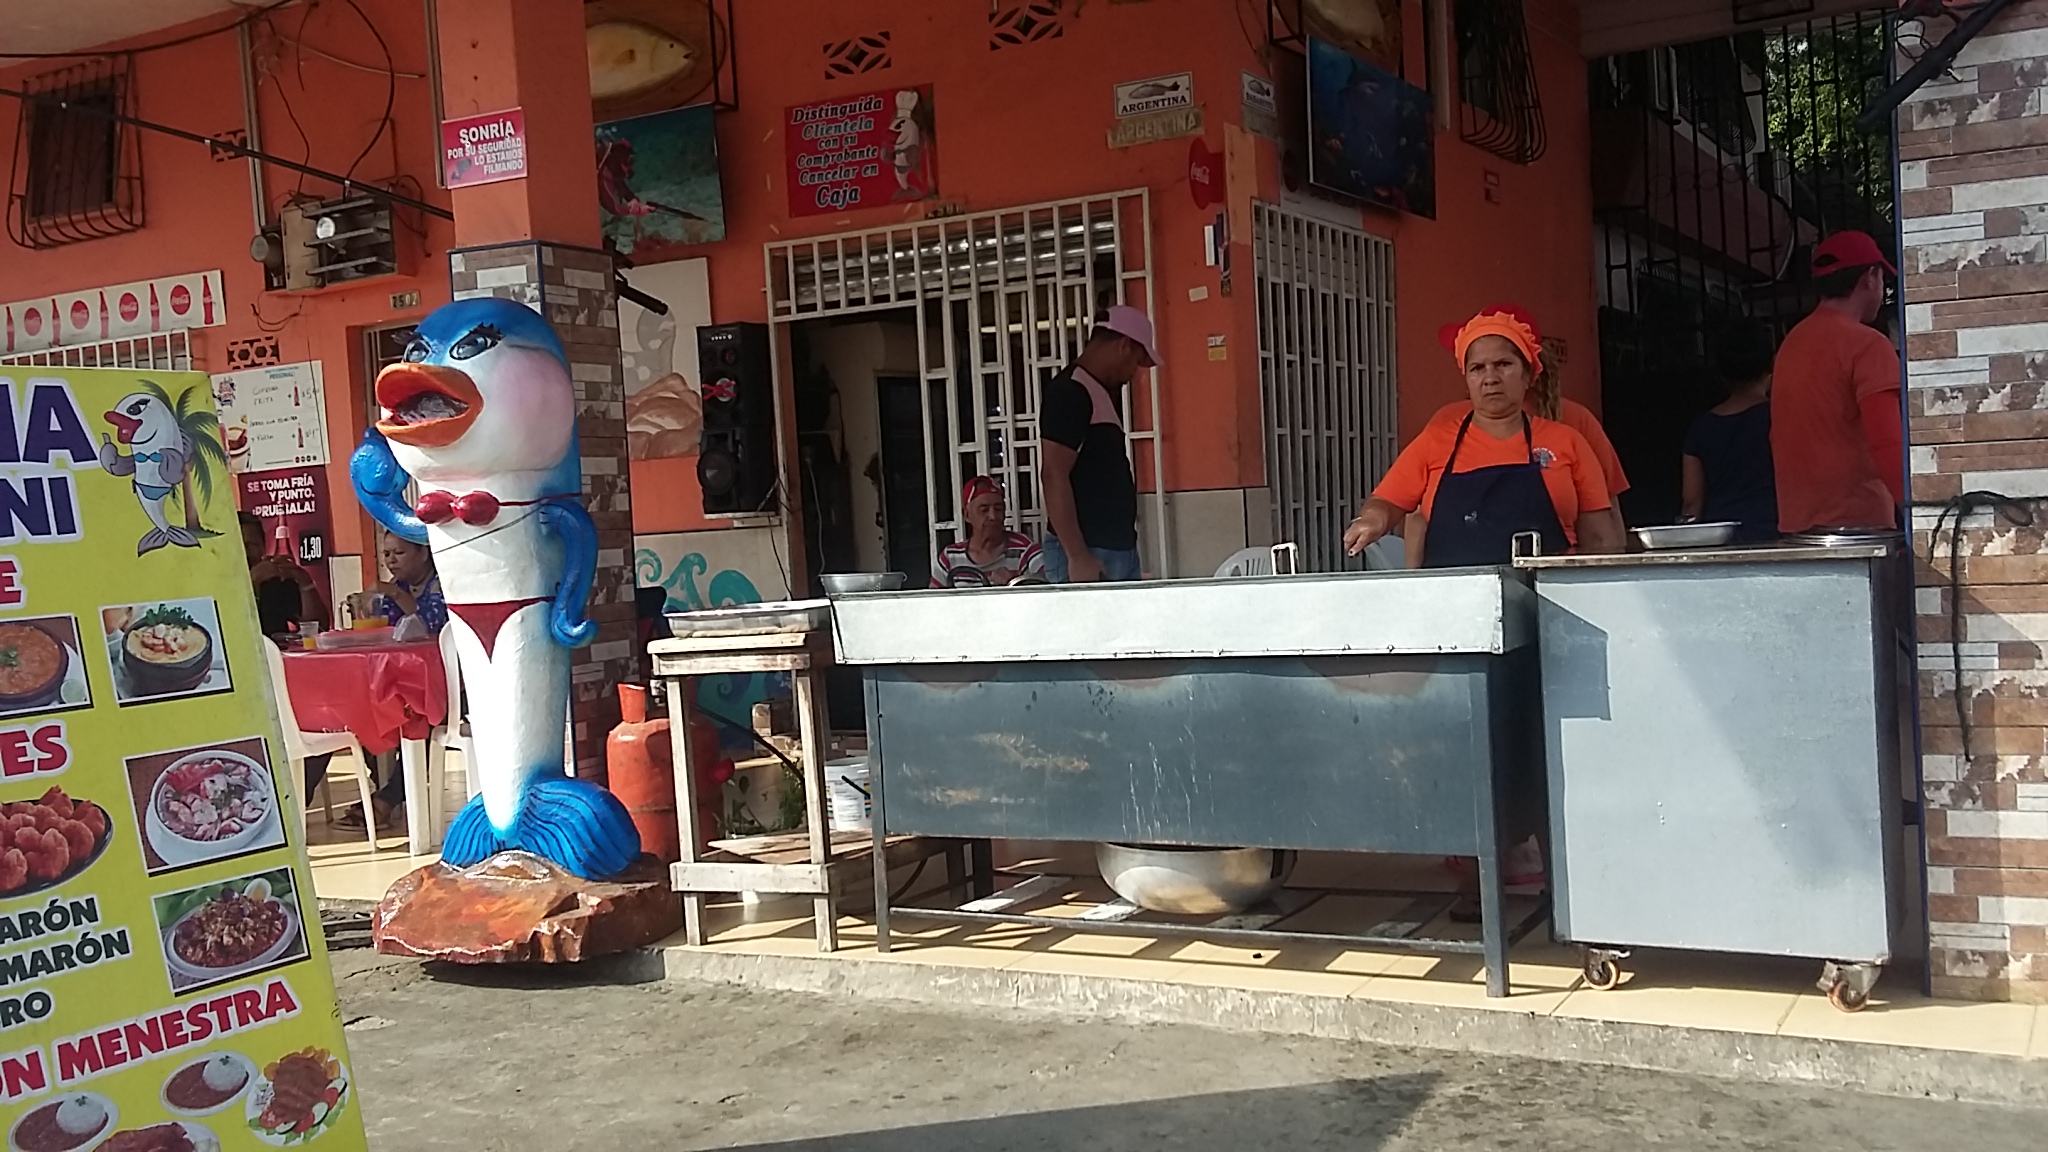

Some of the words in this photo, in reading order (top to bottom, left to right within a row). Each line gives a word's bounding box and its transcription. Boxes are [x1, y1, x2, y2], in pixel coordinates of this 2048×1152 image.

[792, 95, 883, 124] Distinguida
[1121, 95, 1187, 114] ARGENTINA
[459, 118, 515, 144] SONRÍA
[803, 117, 873, 139] Clientela
[447, 148, 464, 160] POR
[465, 144, 476, 156] SU
[477, 137, 522, 154] SEGURIDAD
[818, 137, 839, 150] con
[843, 134, 857, 146] su
[474, 156, 485, 166] LO
[486, 148, 523, 164] ESTAMOS
[483, 160, 523, 176] FILMANDO
[797, 146, 878, 168] Comprobante
[800, 165, 858, 186] Cancelar
[863, 164, 878, 176] en
[816, 182, 860, 209] Caja
[247, 481, 260, 493] SE
[260, 478, 290, 491] TOMA
[291, 472, 315, 488] FRÍA
[268, 491, 277, 502] Y
[277, 487, 316, 500] PUNTO.
[0, 724, 68, 777] ES
[0, 897, 99, 945] ARÓN
[0, 929, 130, 986] MARÓN
[0, 991, 52, 1028] RO
[0, 1050, 46, 1098] N
[57, 981, 298, 1082] MENESTRA
